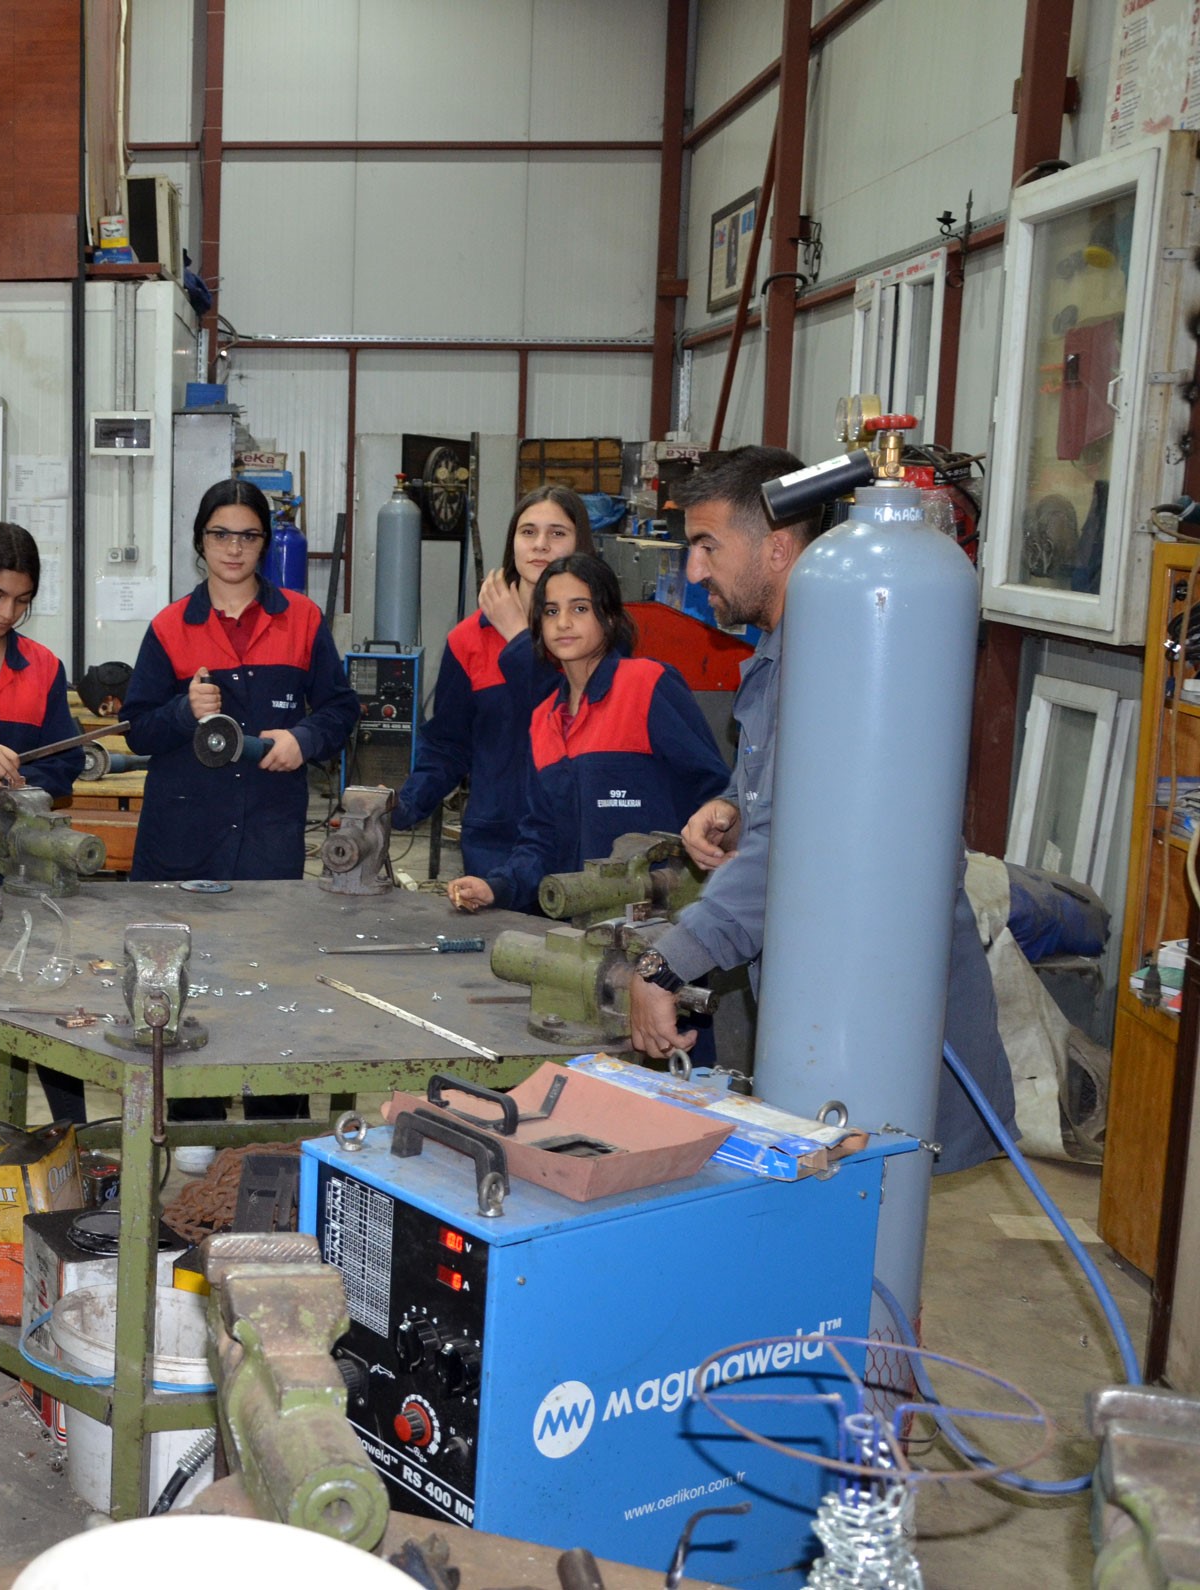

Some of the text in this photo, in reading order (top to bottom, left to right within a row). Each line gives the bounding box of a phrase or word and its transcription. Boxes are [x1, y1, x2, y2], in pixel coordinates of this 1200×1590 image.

[609, 789, 627, 798] 997
[465, 1242, 472, 1253] V
[462, 1281, 470, 1291] A
[402, 1465, 422, 1489] RS
[425, 1482, 451, 1508] 400
[624, 1470, 746, 1521] www.oerlikon.com.tr
